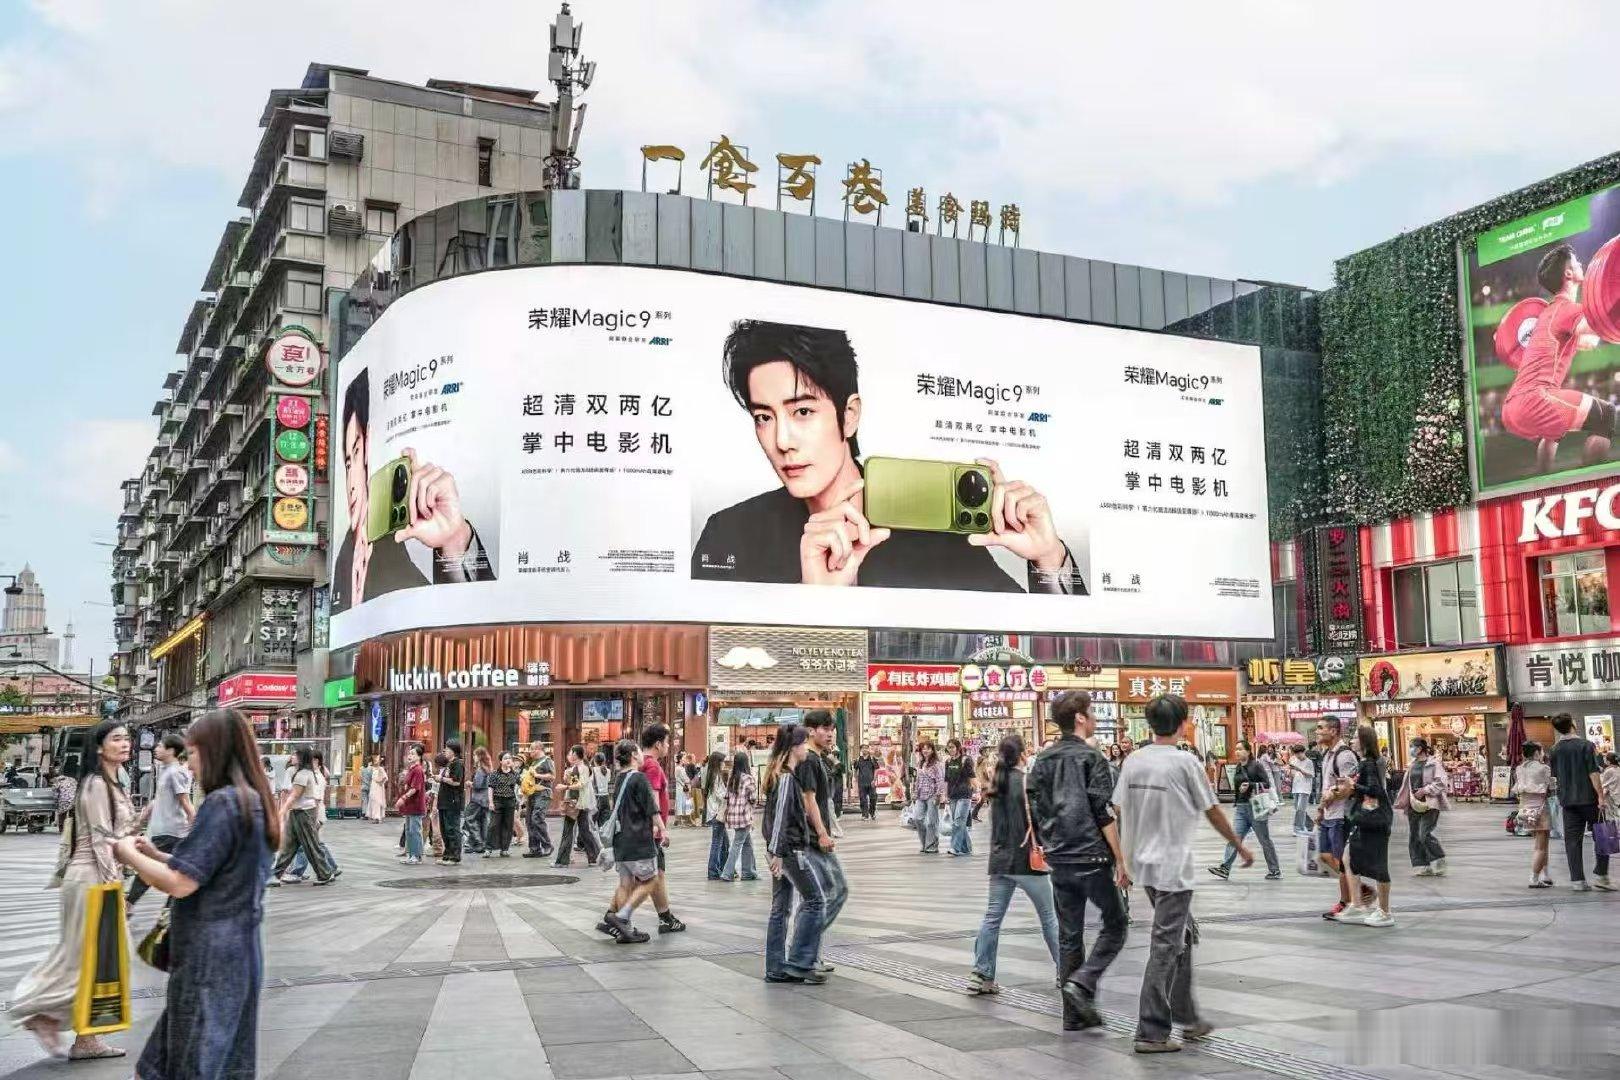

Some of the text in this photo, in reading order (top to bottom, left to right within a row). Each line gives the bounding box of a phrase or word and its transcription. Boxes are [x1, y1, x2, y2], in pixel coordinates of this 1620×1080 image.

[522, 394, 673, 417] 超清双两亿
[522, 431, 673, 455] 掌中电影机
[1123, 438, 1227, 467] 超清双两亿
[1124, 470, 1229, 498] 掌中电影机
[390, 663, 519, 691] luckin coffee
[1526, 651, 1620, 688] 肯悦咖
